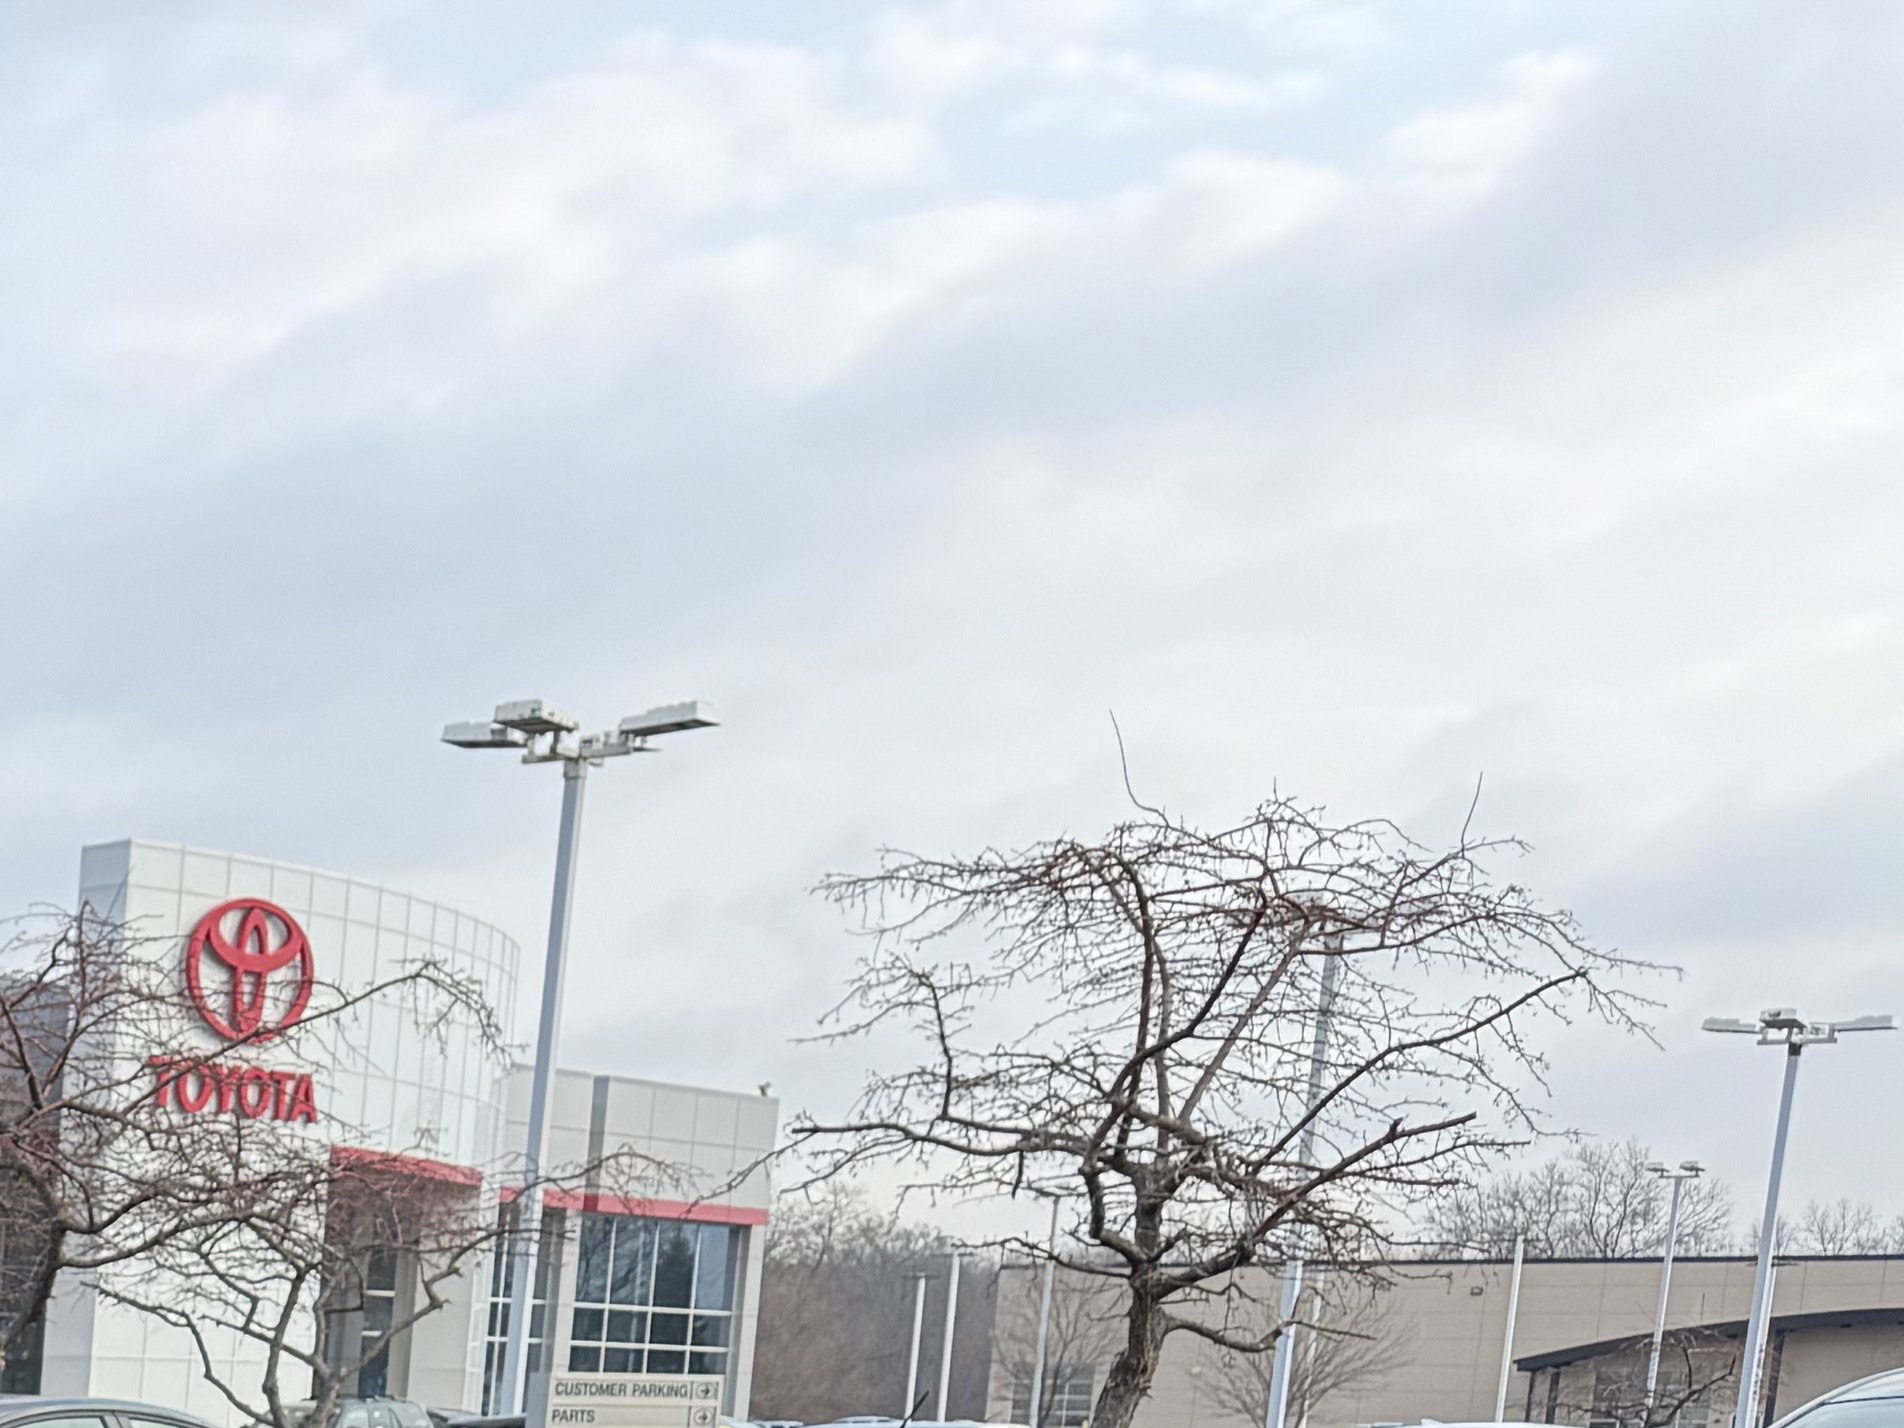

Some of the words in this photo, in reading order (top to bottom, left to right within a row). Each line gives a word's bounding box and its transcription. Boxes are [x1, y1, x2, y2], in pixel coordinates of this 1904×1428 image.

[149, 1055, 318, 1124] TOYOTA
[554, 1381, 627, 1398] CUSTOMER
[632, 1383, 688, 1399] PARKING
[551, 1408, 595, 1424] PARTS
